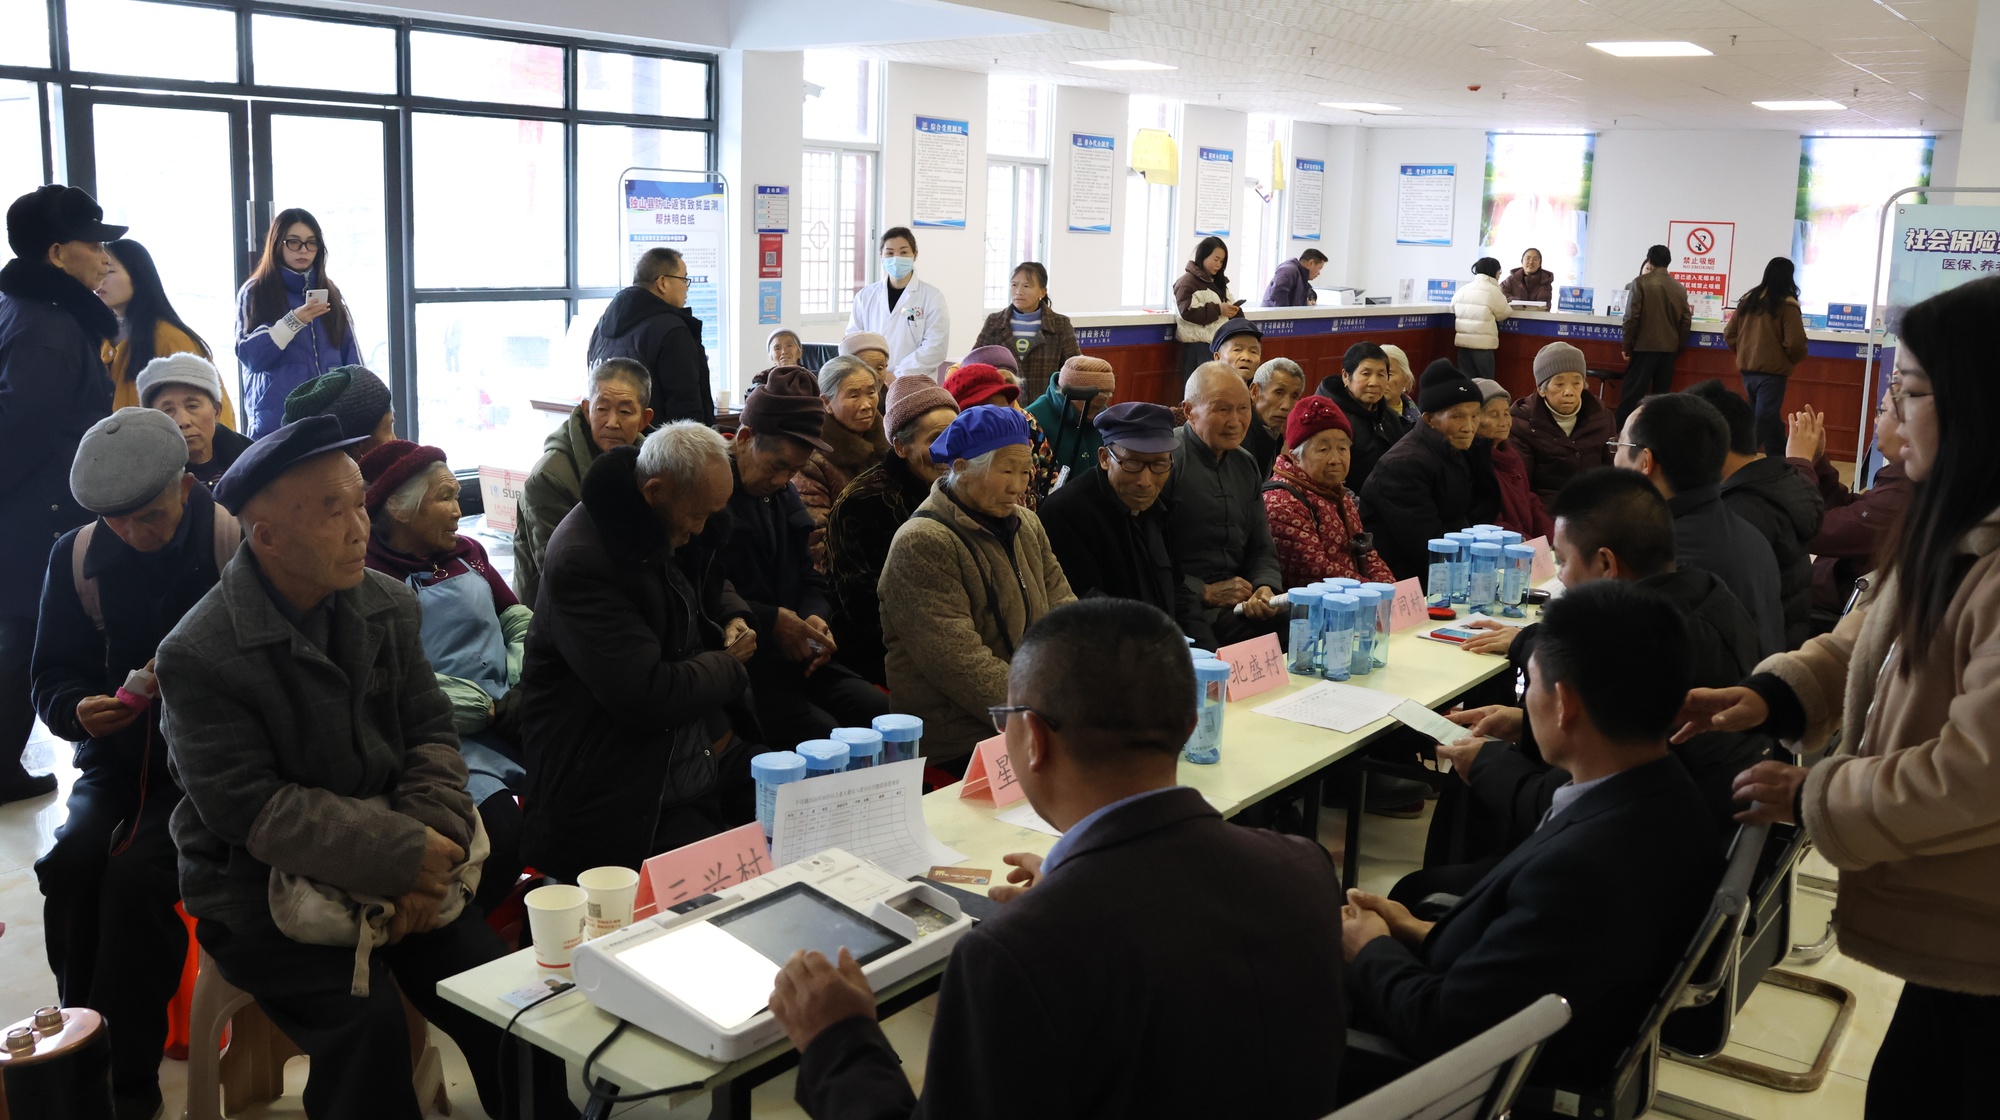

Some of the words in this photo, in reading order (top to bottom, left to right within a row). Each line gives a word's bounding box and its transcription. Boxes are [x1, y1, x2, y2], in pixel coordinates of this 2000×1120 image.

[630, 197, 719, 211] 独山县防止返贫致贫监测
[655, 213, 695, 225] 帮扶明白纸
[1904, 227, 2000, 254] 社会保险
[1683, 256, 1715, 265] 禁止吸烟
[1674, 273, 1721, 282] 您已进入无烟单位
[1231, 649, 1280, 684] 北盛村
